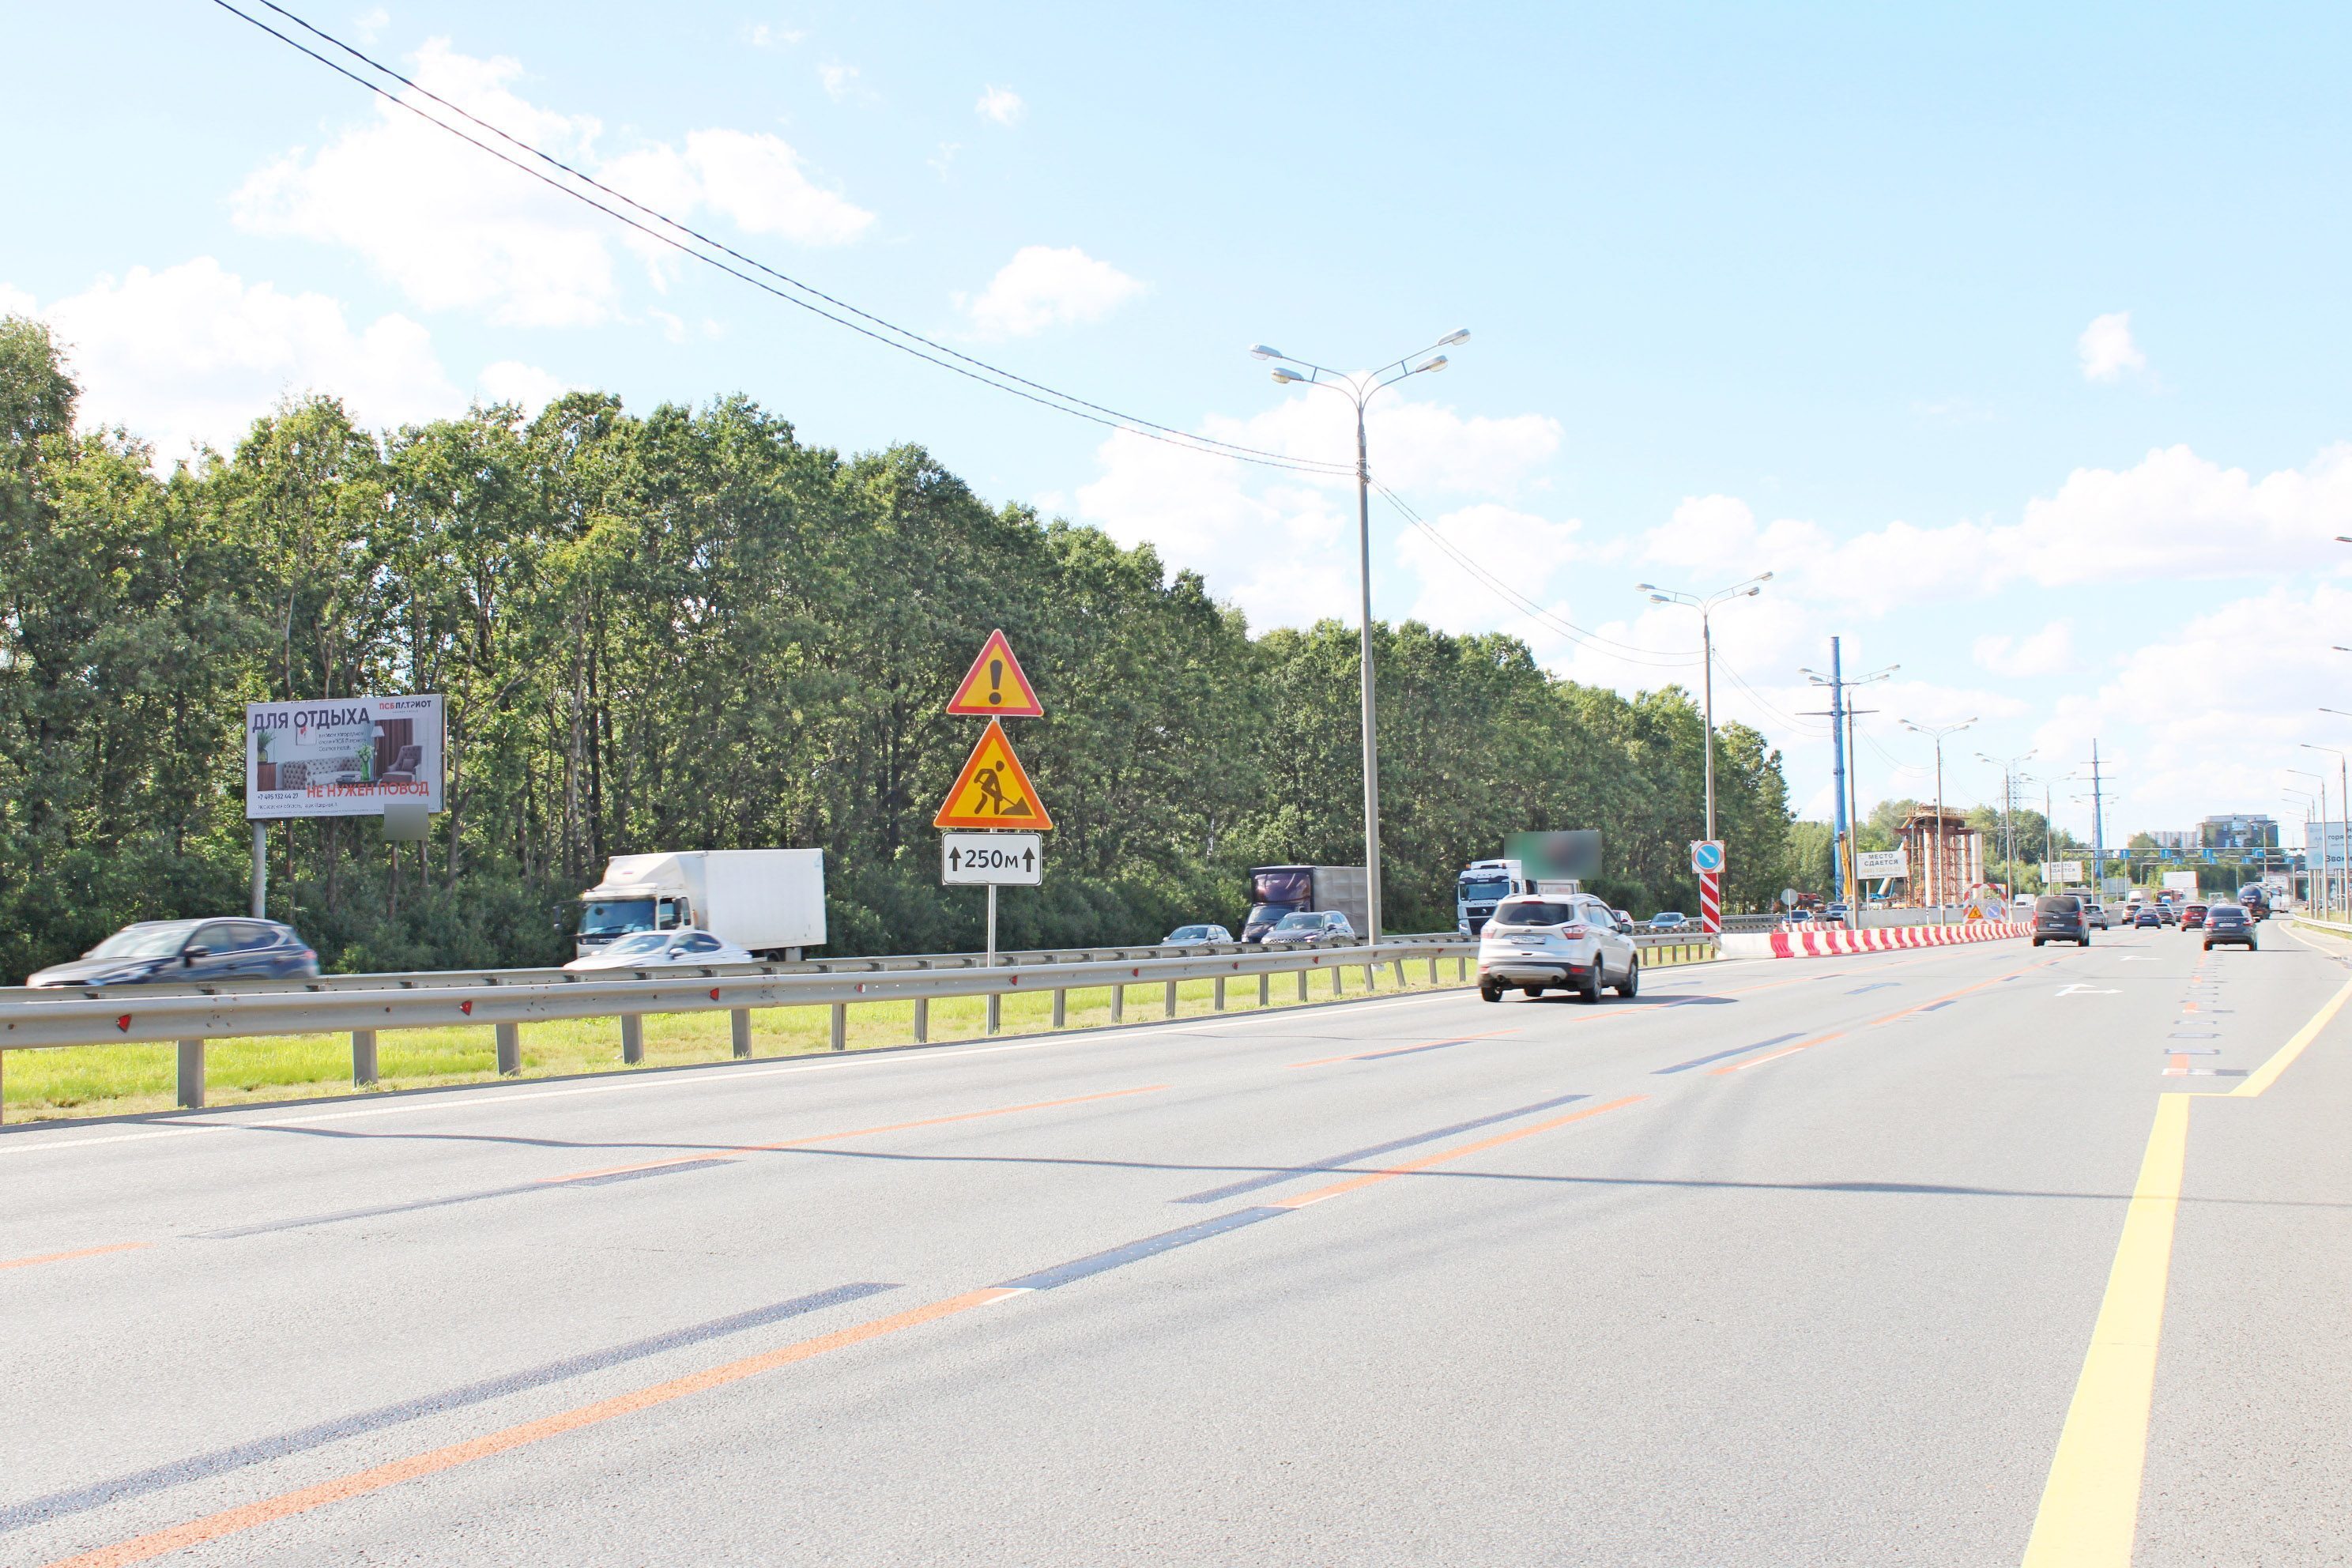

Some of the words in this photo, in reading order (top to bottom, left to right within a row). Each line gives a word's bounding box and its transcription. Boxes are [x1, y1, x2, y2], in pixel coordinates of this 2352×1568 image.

[252, 712, 288, 733] ДЛЯ
[294, 707, 371, 729] ОТДЫХА
[307, 785, 323, 798] НЕ
[327, 782, 374, 797] НУЖЕН
[379, 781, 430, 797] ПОВОД
